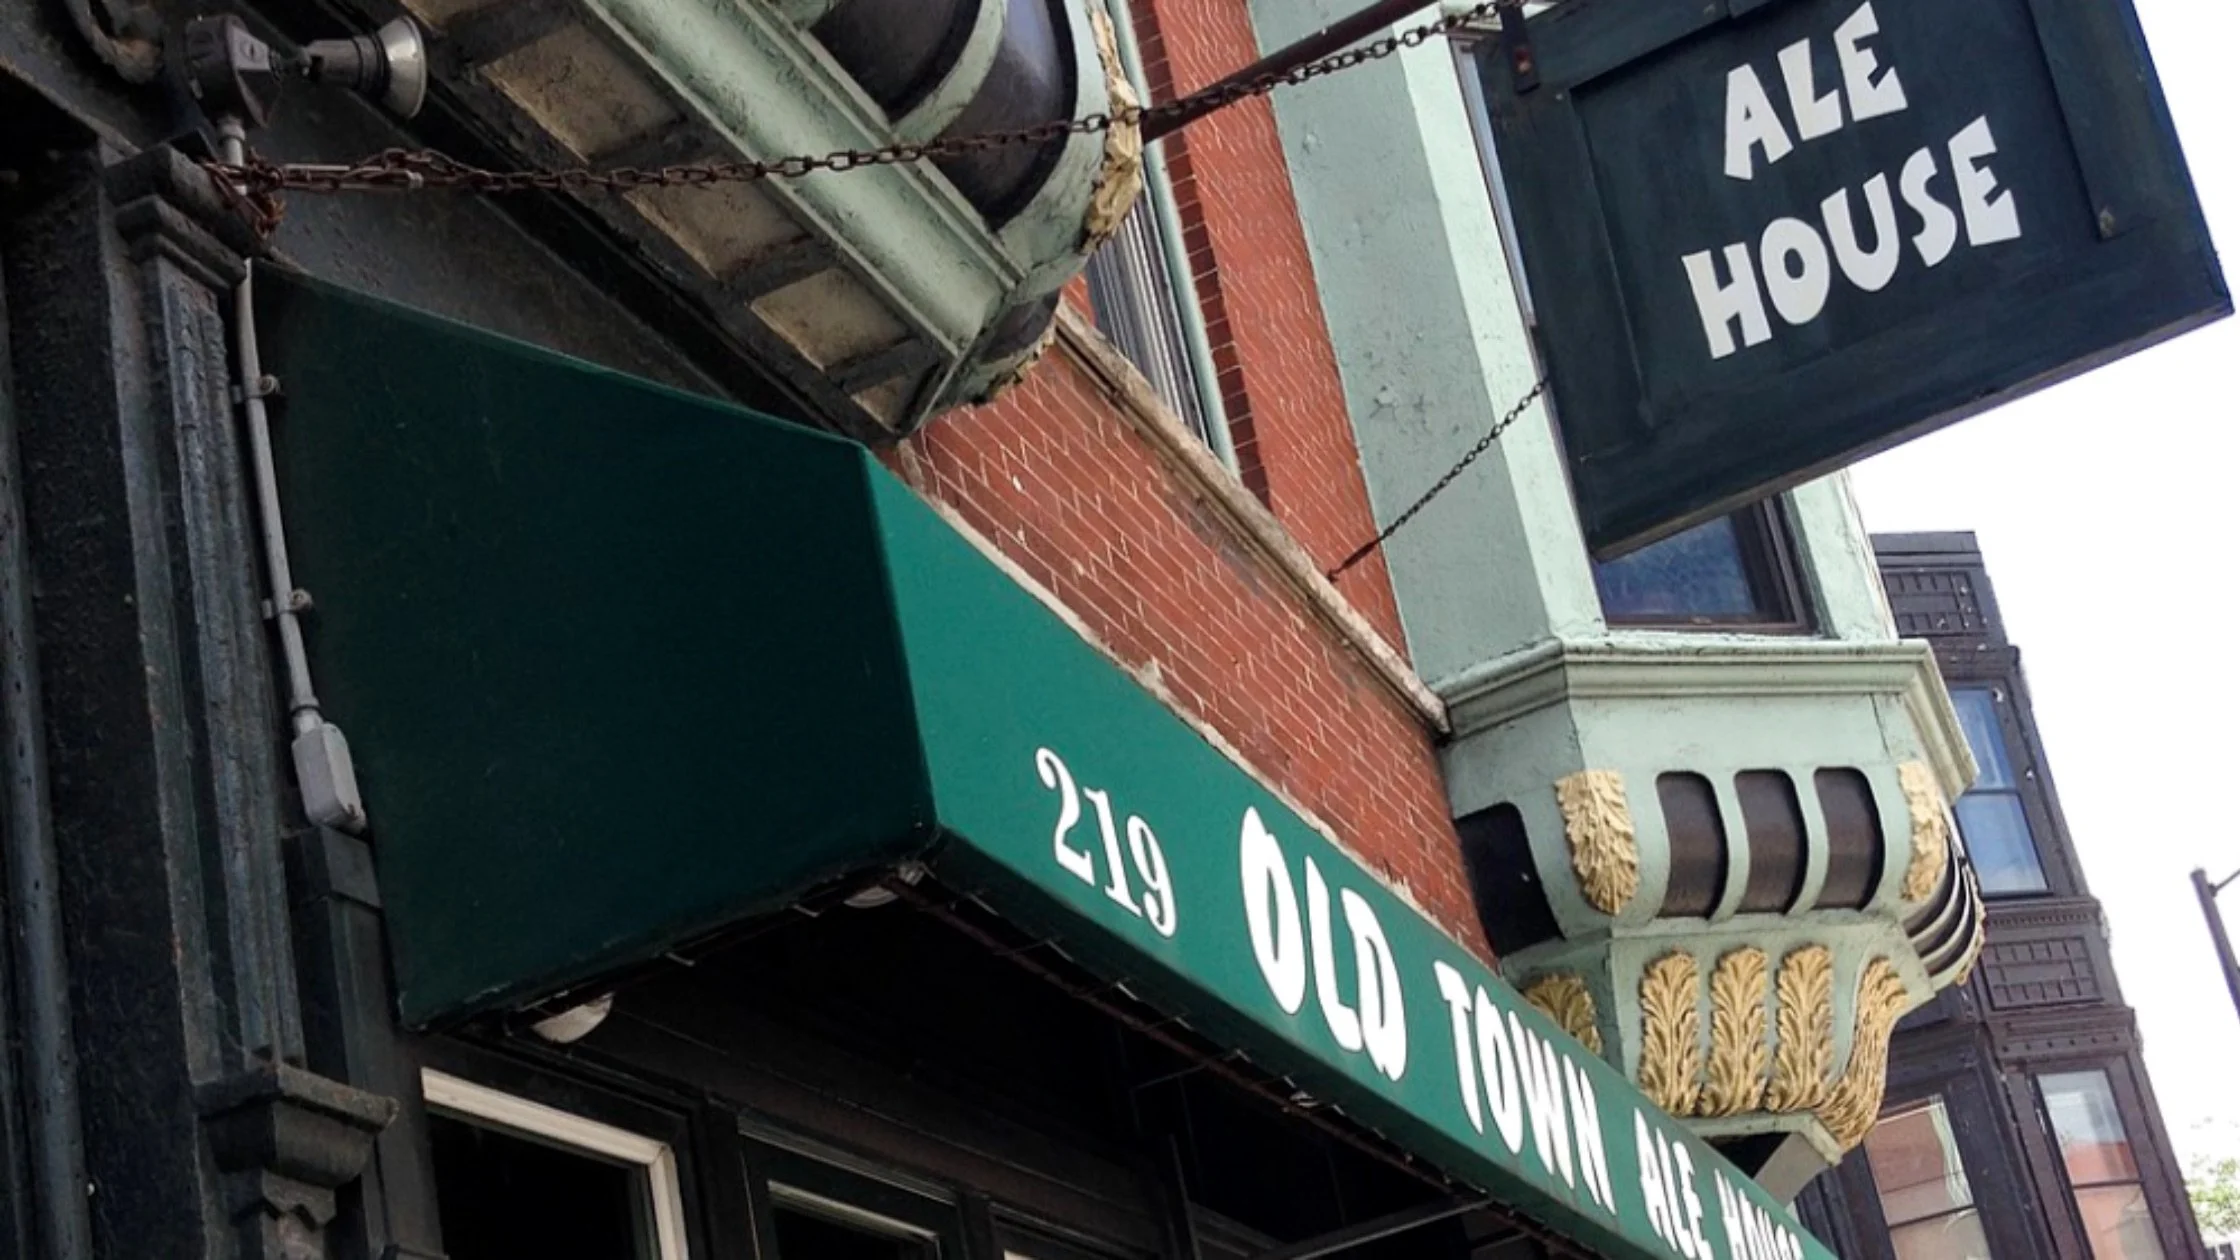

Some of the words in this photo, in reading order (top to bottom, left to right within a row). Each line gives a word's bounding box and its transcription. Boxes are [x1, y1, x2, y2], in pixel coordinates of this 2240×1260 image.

[1723, 1, 1909, 181] ALE
[1681, 114, 2022, 360] HOUSE
[1034, 746, 1178, 939] 219
[1239, 805, 1408, 1082] OLD
[1433, 959, 1618, 1216] TOWN
[1633, 1106, 1714, 1260] ALE
